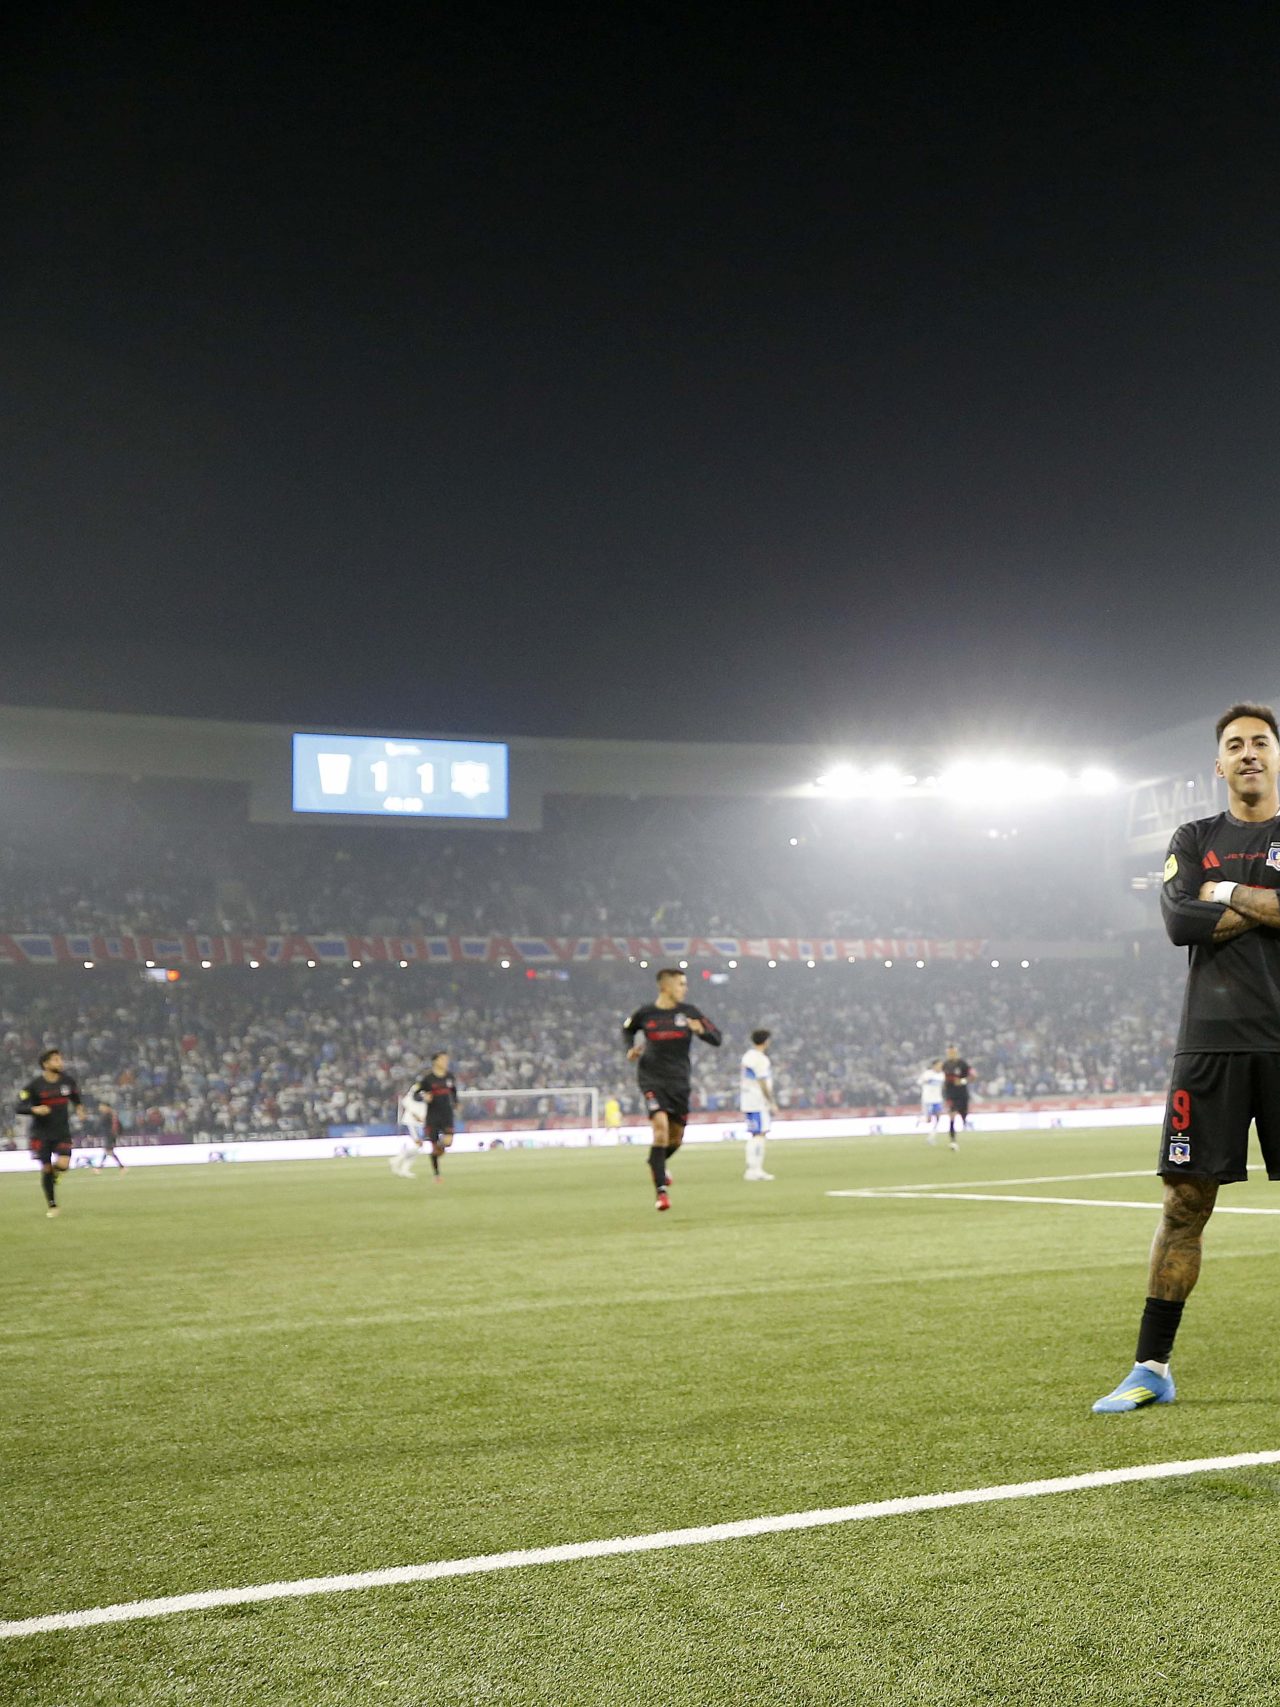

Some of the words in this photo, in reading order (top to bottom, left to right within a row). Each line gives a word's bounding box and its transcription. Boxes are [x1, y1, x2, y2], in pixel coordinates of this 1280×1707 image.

[370, 760, 388, 792] 1
[416, 762, 434, 794] 1
[1171, 1089, 1191, 1131] 9
